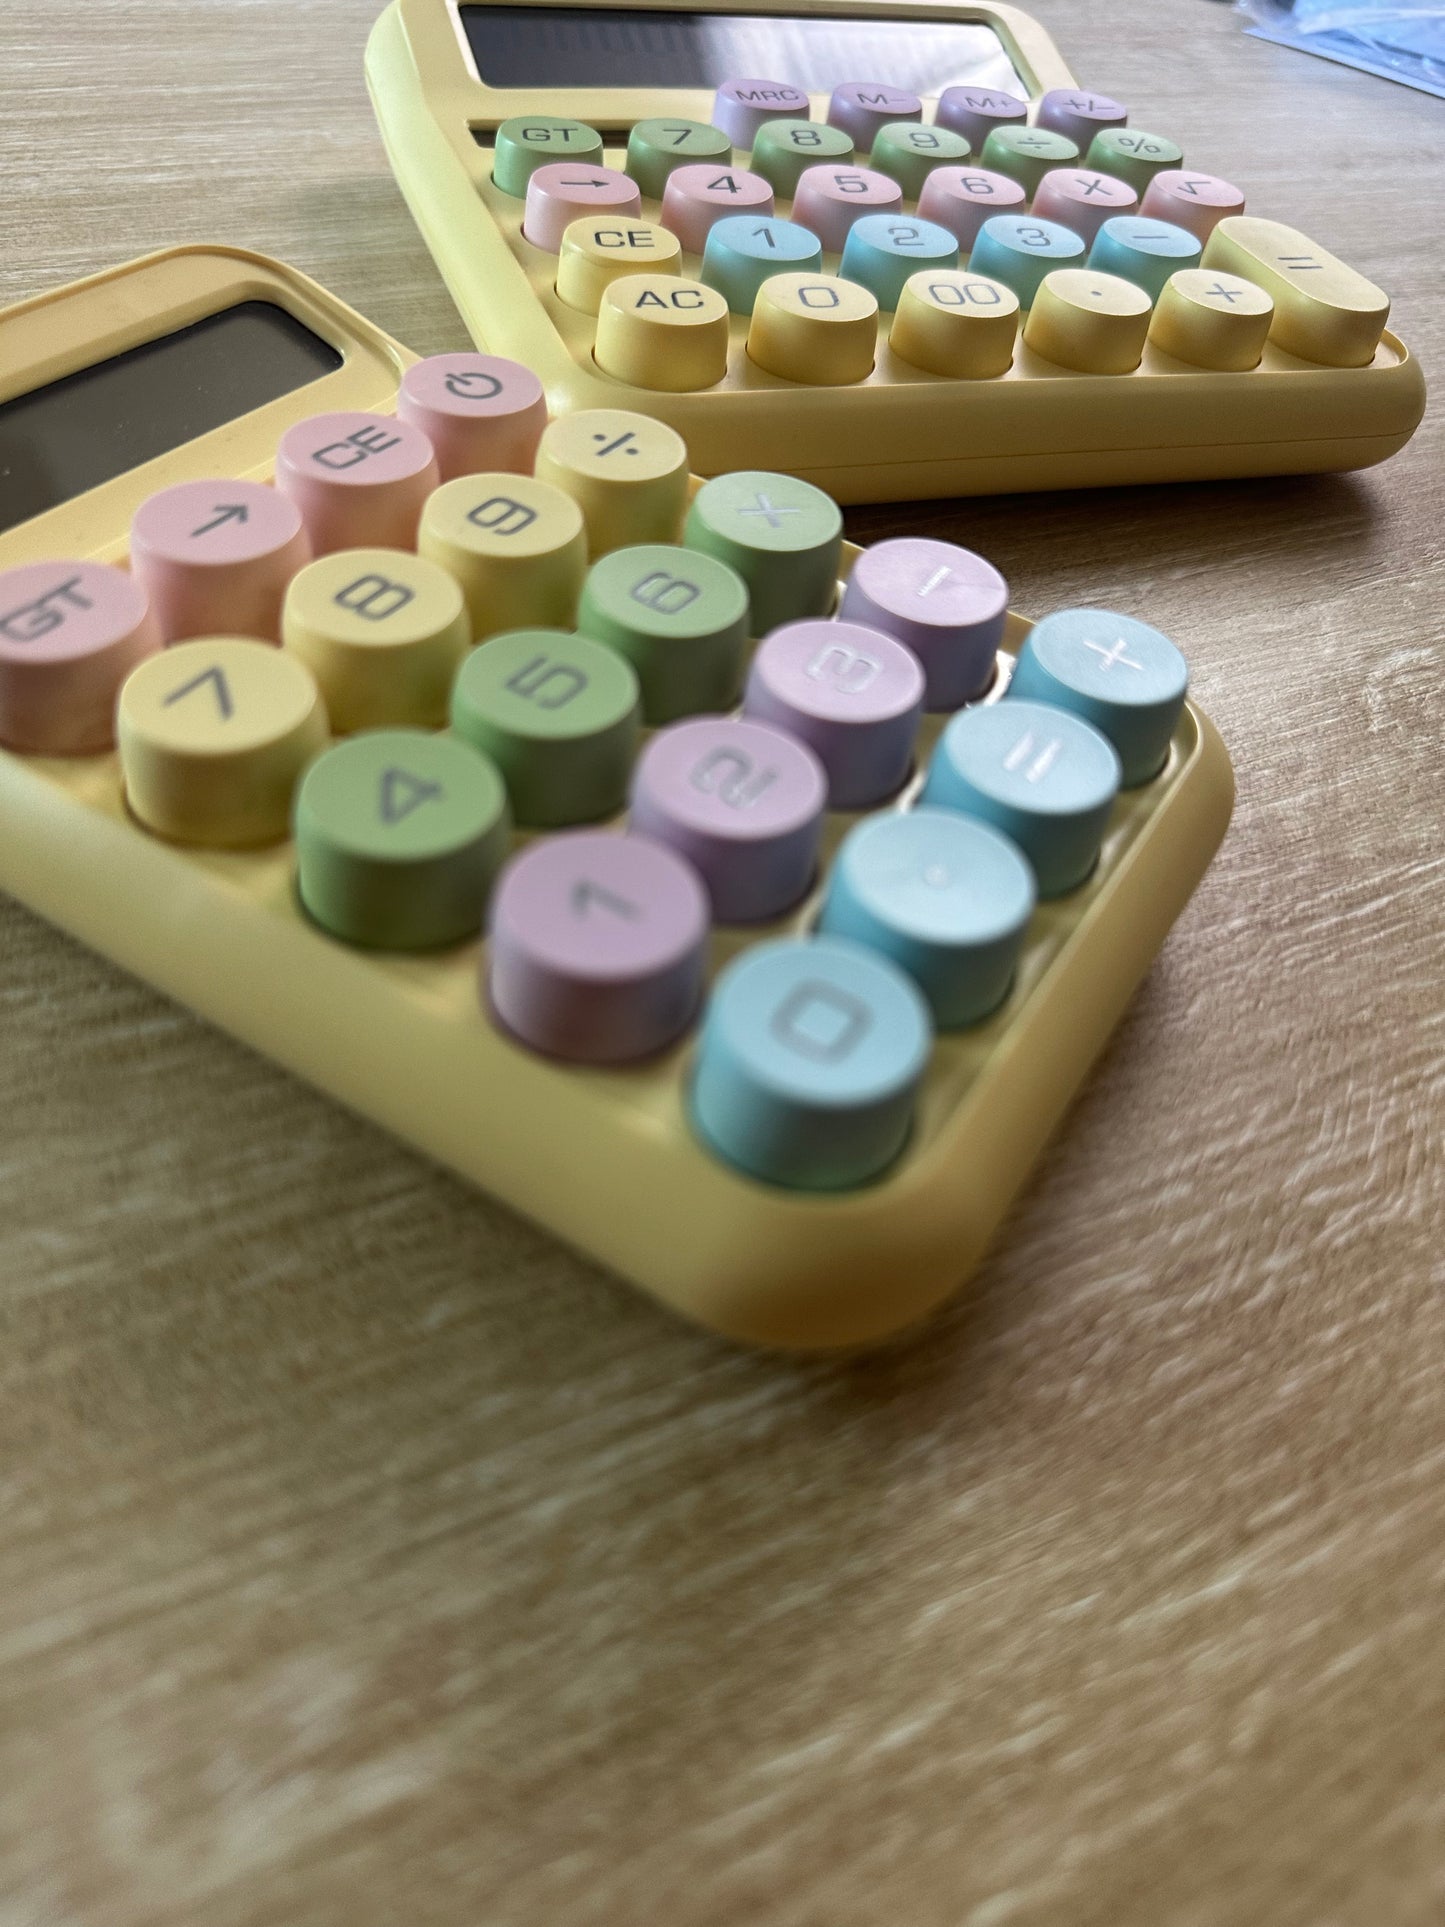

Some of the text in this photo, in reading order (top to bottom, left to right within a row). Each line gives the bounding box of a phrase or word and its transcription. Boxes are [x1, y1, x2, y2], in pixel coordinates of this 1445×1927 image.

[736, 89, 799, 102] MRC
[967, 96, 1013, 109] M+
[522, 127, 578, 142] GT
[663, 129, 692, 145] 7
[790, 129, 822, 146] 8
[908, 131, 937, 149] 9
[1118, 136, 1160, 155] %
[707, 175, 742, 194] 4
[834, 173, 868, 194] 5
[960, 176, 993, 195] 6
[594, 230, 655, 248] CE
[752, 228, 777, 248] 1
[888, 227, 925, 246] 2
[1016, 227, 1050, 248] 3
[635, 290, 704, 309] AC
[798, 287, 840, 308] 0
[929, 283, 1000, 306] 00
[312, 426, 402, 470] CE
[466, 496, 538, 536] 9
[333, 574, 416, 622] 8
[631, 572, 700, 615] 6
[0, 575, 94, 642] GT
[803, 645, 882, 692] 3
[506, 653, 589, 710] 5
[160, 664, 235, 721] 7
[691, 746, 778, 807] 2
[380, 767, 442, 826] 4
[570, 880, 642, 920] 1
[770, 979, 871, 1064] 0
